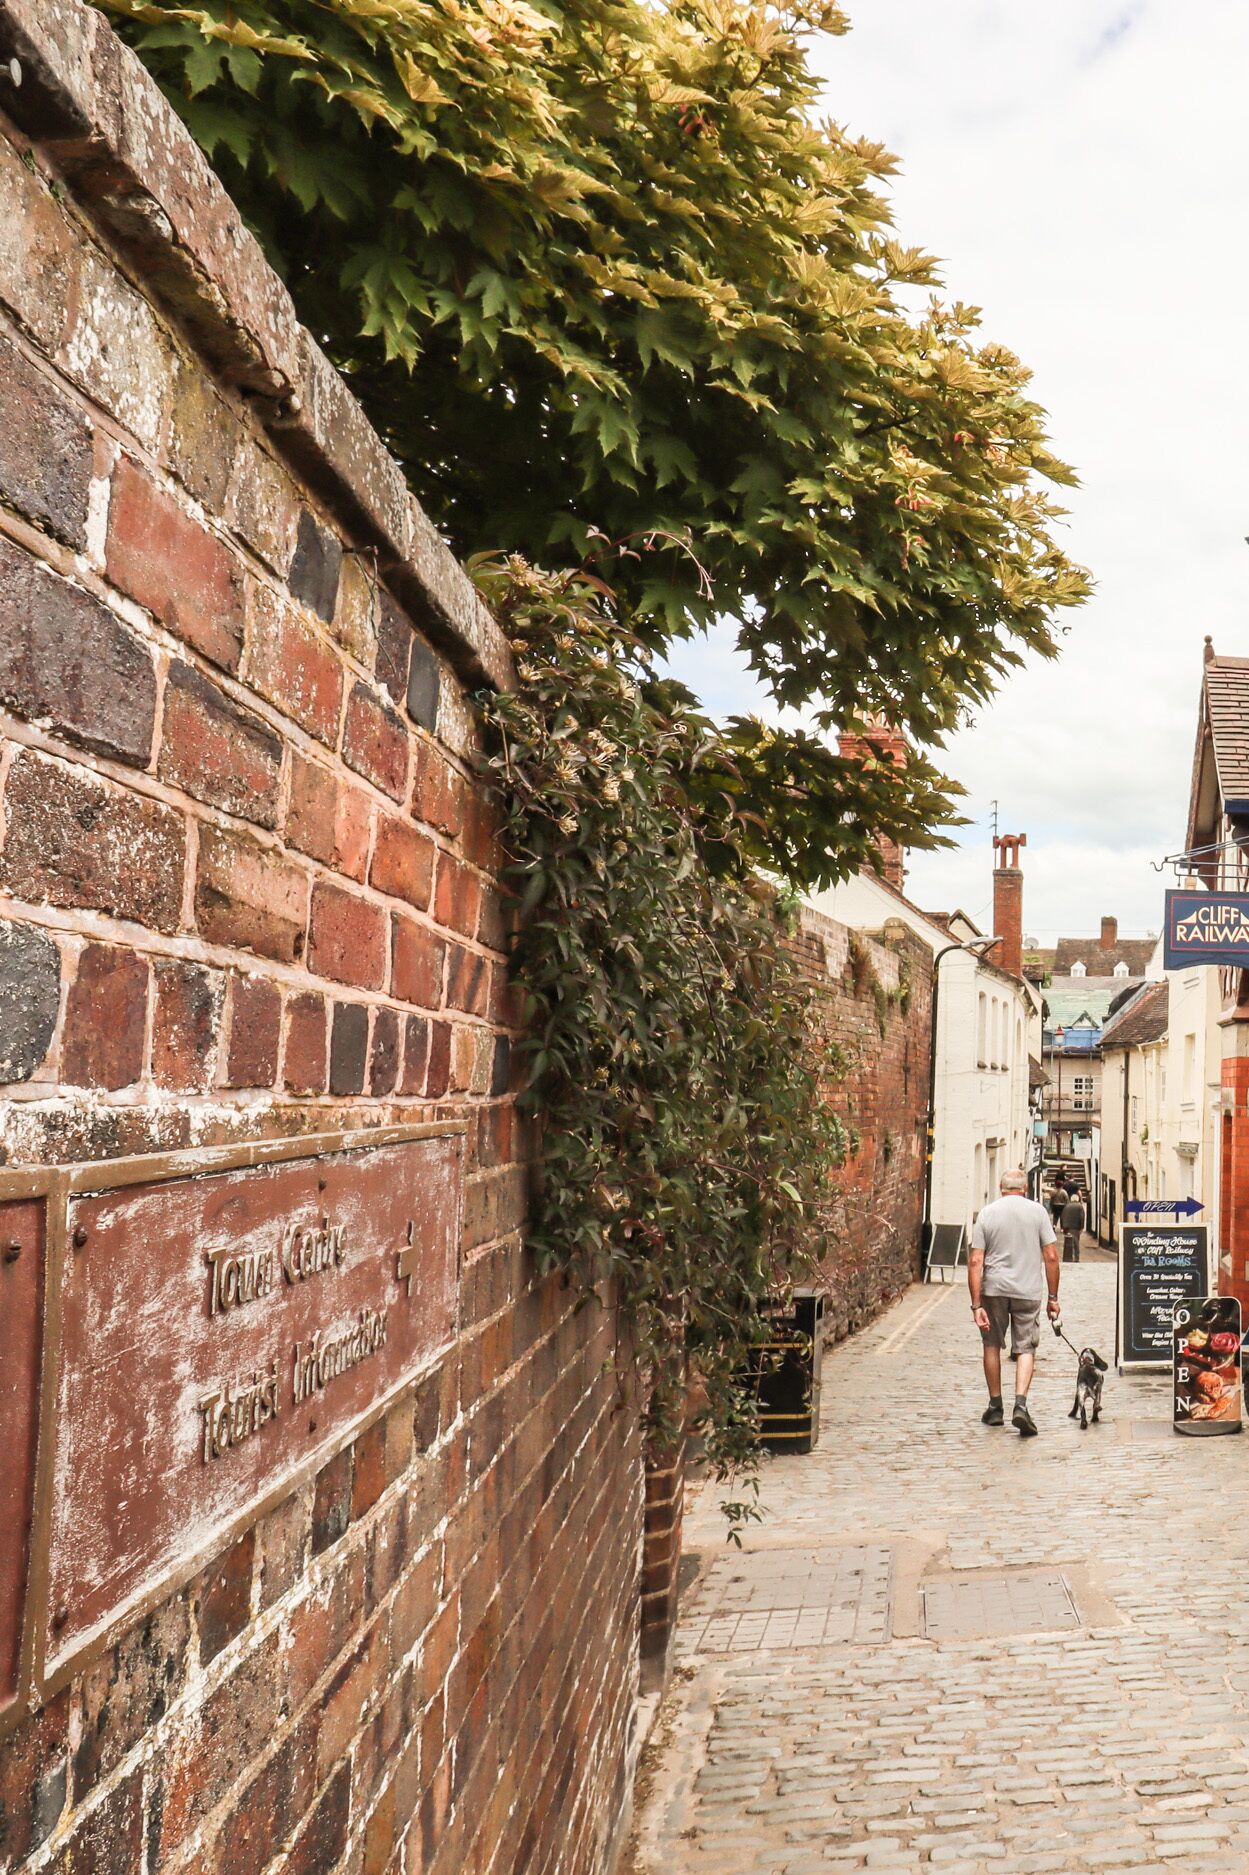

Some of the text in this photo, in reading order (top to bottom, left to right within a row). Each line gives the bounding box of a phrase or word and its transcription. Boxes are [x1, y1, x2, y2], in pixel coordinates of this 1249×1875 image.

[1198, 906, 1239, 925] CLIFF
[1143, 1201, 1176, 1212] OPEN
[1132, 1237, 1198, 1248] Winding House
[1147, 1246, 1164, 1255] Cliff
[1165, 1246, 1195, 1256] Railway
[207, 1216, 347, 1316] Town Centre
[1176, 1309, 1191, 1412] OPEN
[200, 1309, 388, 1463] Tourist Information
